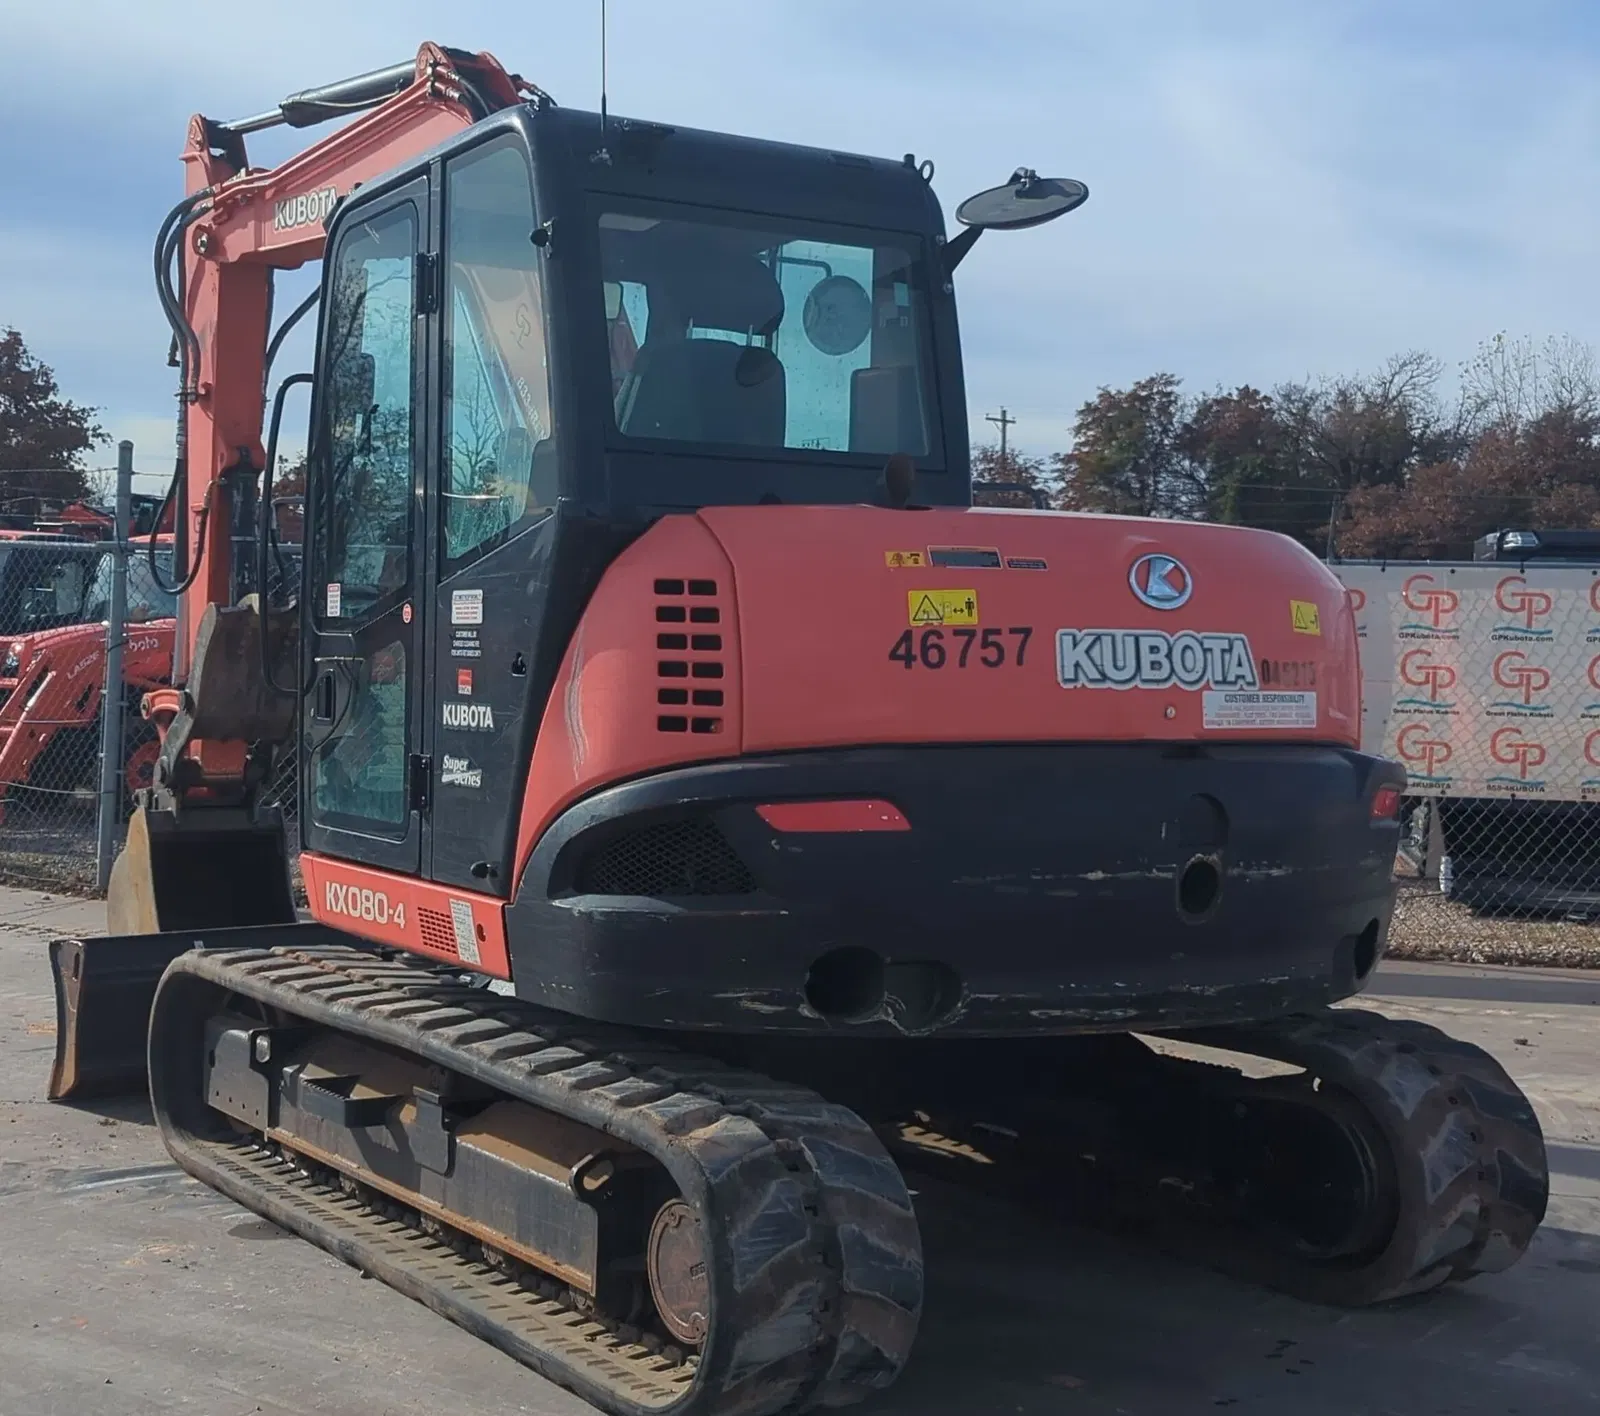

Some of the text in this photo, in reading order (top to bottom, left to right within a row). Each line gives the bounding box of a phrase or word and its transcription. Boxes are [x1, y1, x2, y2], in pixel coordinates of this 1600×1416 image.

[274, 187, 337, 231] KUBOTA
[1403, 574, 1459, 627] GP
[1495, 575, 1552, 628] GP
[888, 626, 1034, 670] 46757
[1059, 631, 1257, 688] KUBOTA
[1490, 634, 1555, 643] GPKubota.com
[1401, 649, 1457, 702] GP
[1493, 650, 1551, 705] GP
[442, 703, 495, 729] KUBOTA
[442, 754, 470, 774] Super
[1396, 723, 1453, 777] GP
[1490, 727, 1546, 780] GP
[325, 881, 407, 930] KX080-4
